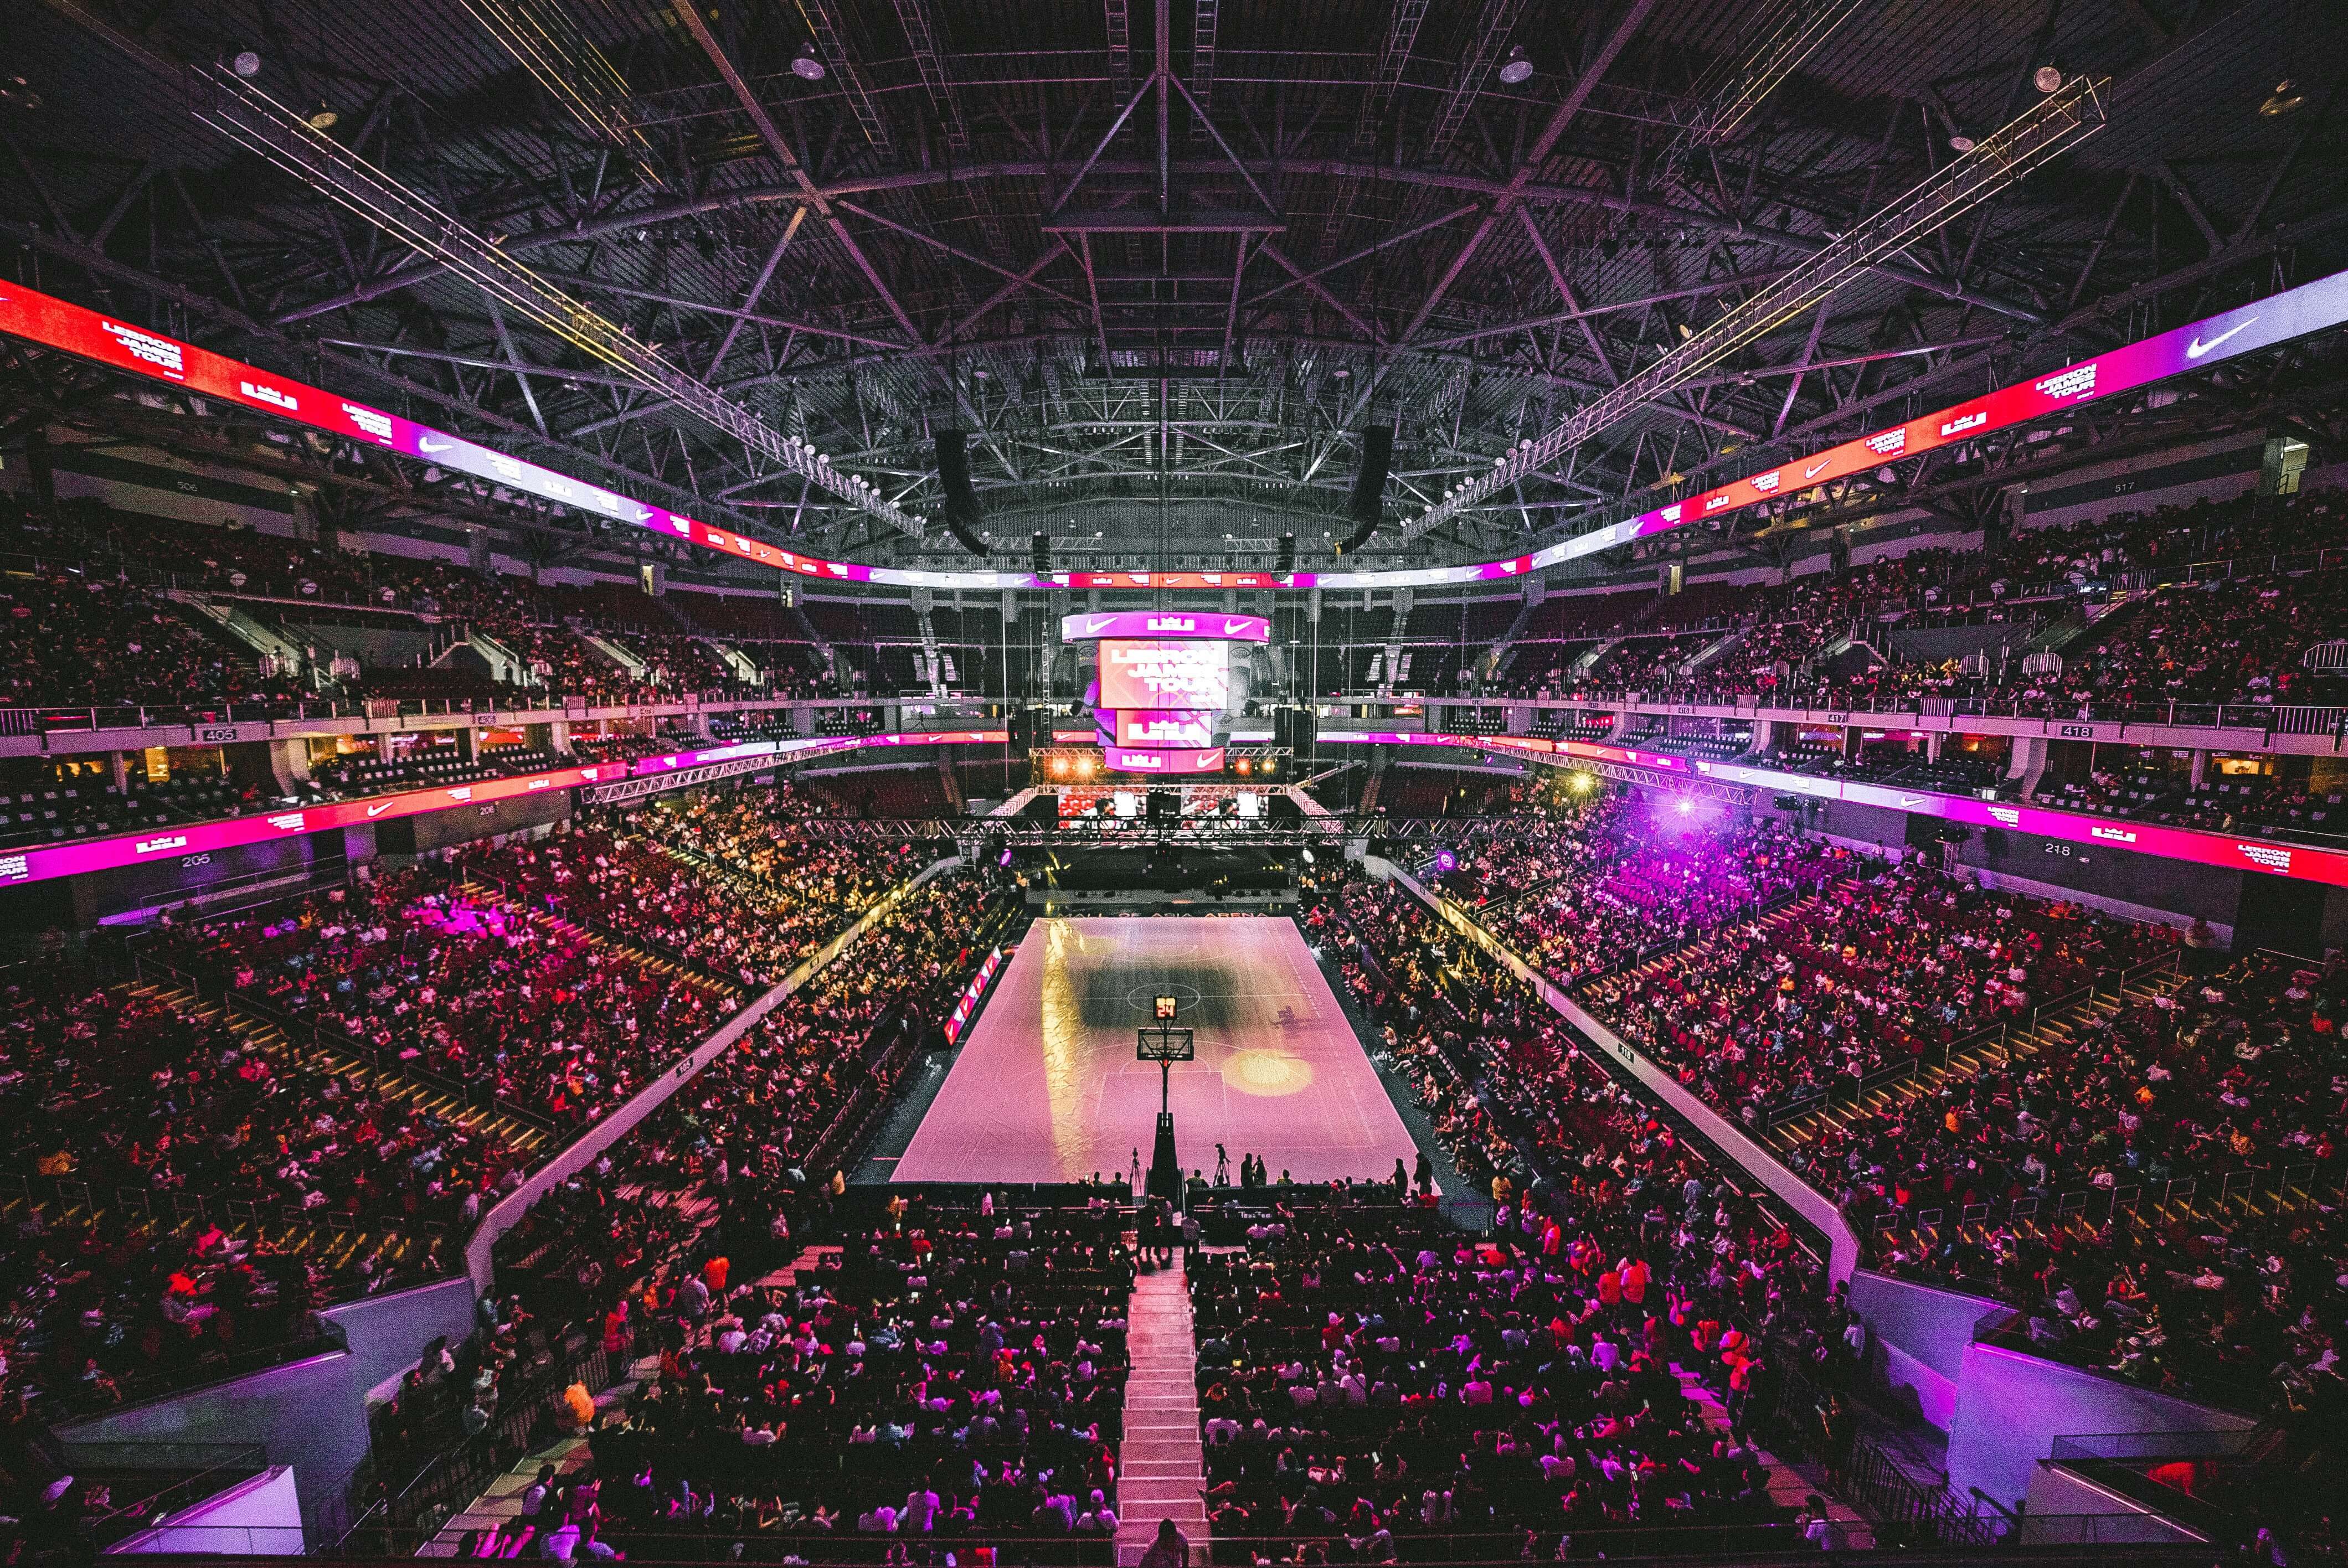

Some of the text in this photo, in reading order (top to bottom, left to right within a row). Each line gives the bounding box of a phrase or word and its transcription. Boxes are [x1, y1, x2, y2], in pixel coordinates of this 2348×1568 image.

[102, 321, 181, 355] LEBRON
[116, 337, 182, 363] JAMES
[129, 347, 183, 371] TOUR
[2036, 363, 2097, 390] LEBRON
[2044, 372, 2096, 395] JAMES
[2052, 380, 2095, 399] TOUR
[1866, 427, 1906, 447] LEBRON
[1871, 434, 1906, 450] JAMES
[1877, 440, 1904, 454] TOUR
[2114, 482, 2134, 492] 517
[1144, 677, 1219, 692] TOUR
[207, 730, 234, 740] 405
[2064, 726, 2089, 737] 418
[2045, 843, 2070, 856] 218
[2238, 844, 2292, 858] LEBRON
[181, 854, 210, 868] 205
[2244, 852, 2290, 862] JAMES
[2252, 857, 2290, 868] TOUR
[1157, 1005, 1173, 1017] 24
[1621, 1046, 1631, 1060] 118
